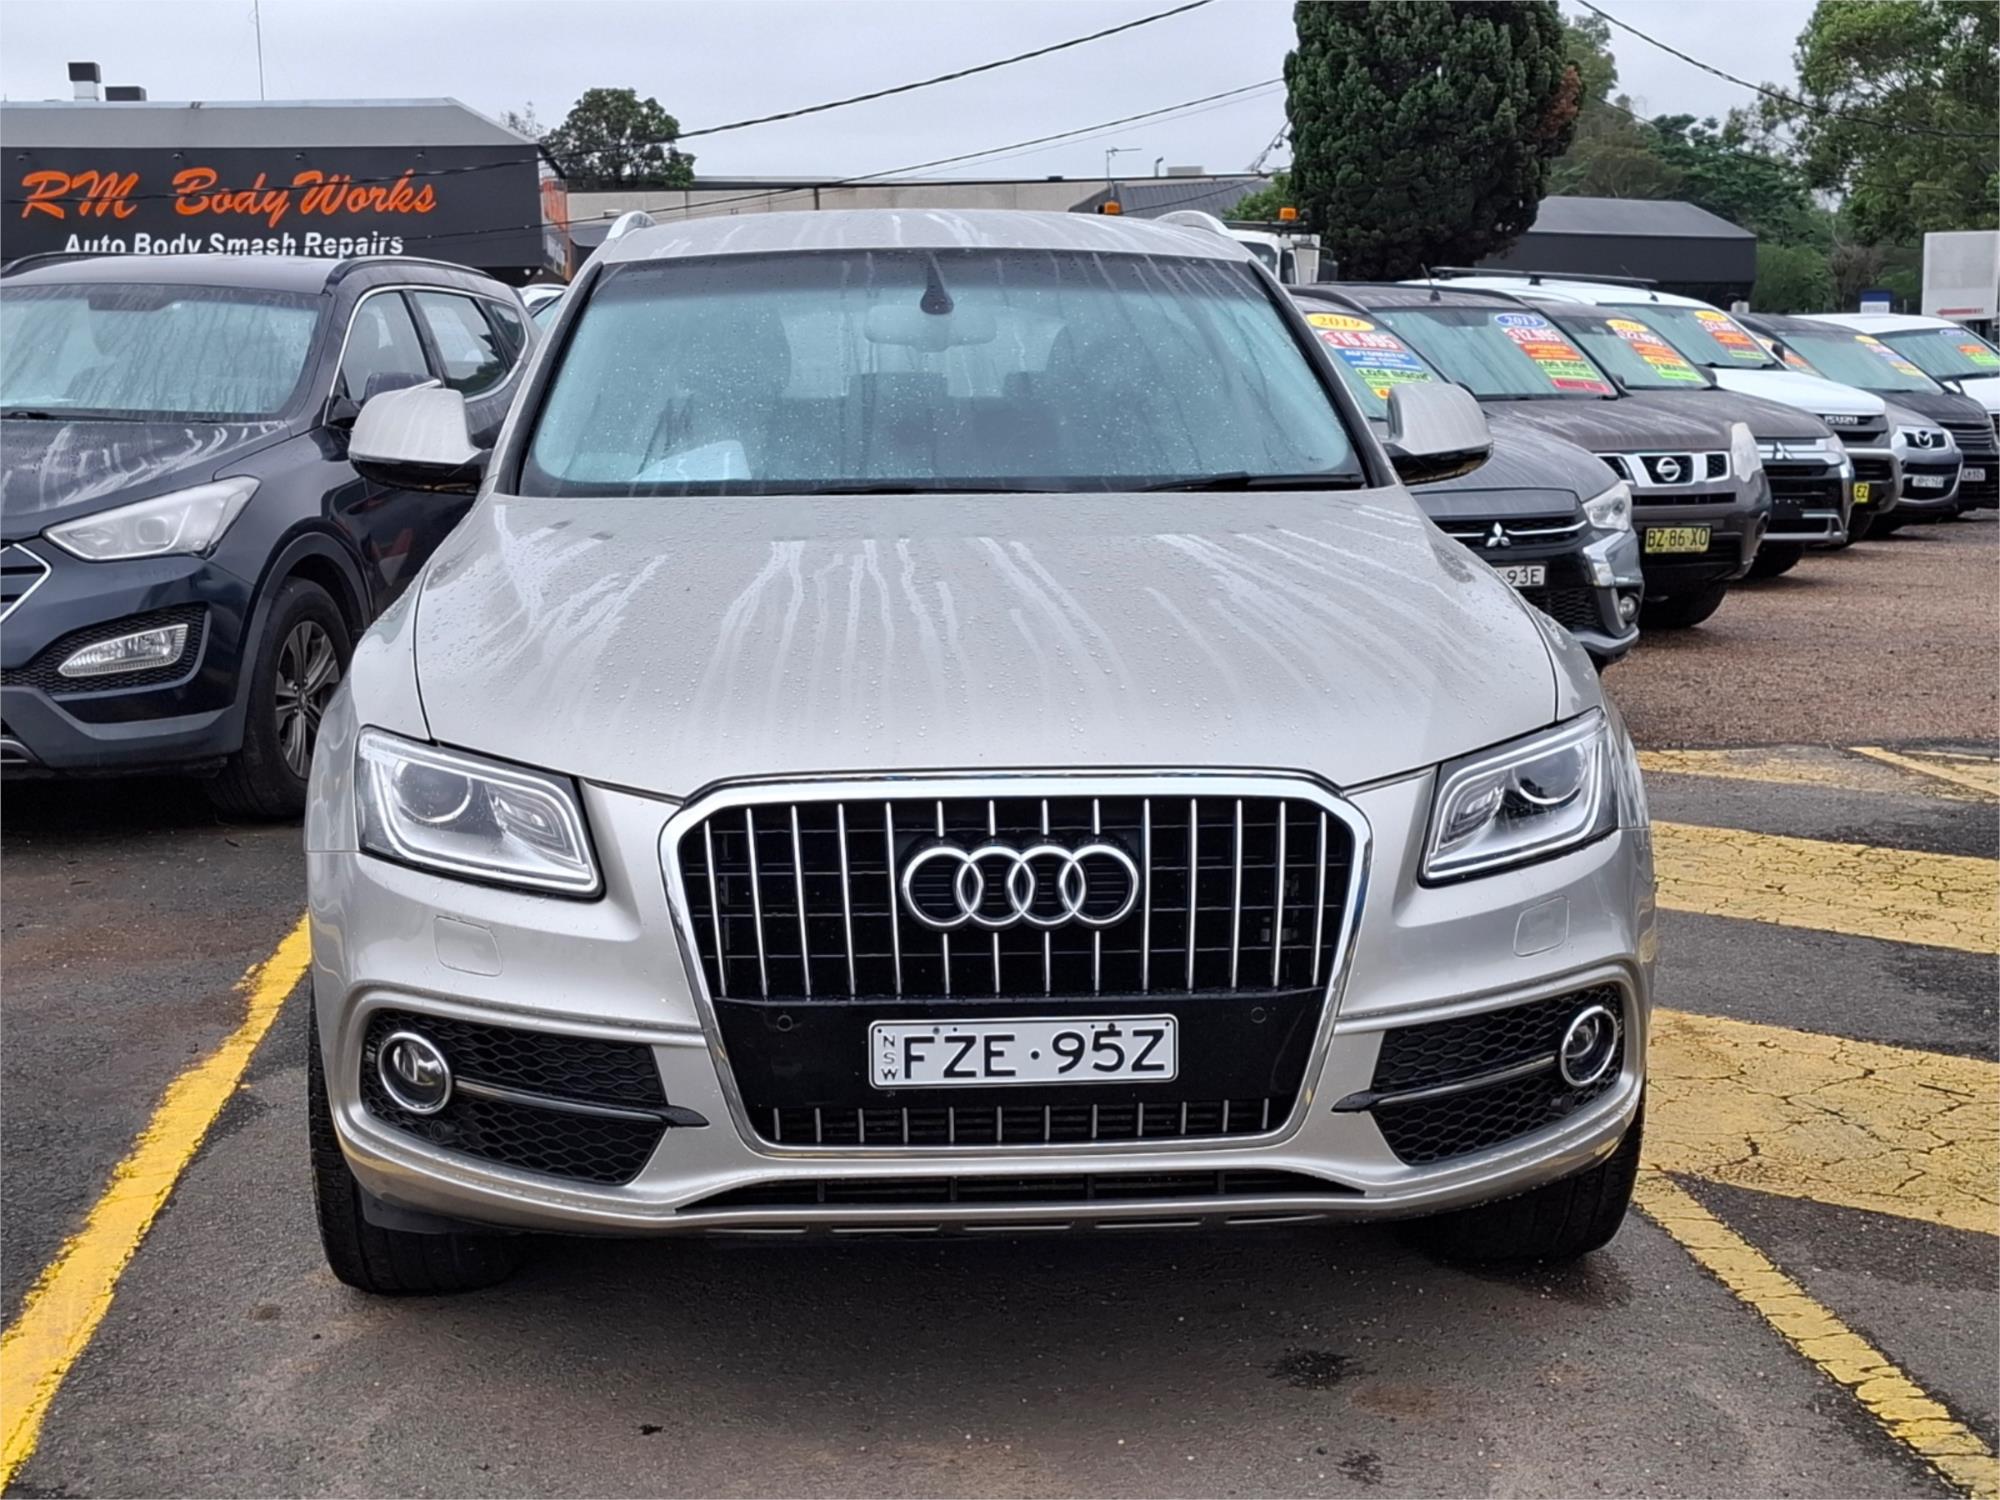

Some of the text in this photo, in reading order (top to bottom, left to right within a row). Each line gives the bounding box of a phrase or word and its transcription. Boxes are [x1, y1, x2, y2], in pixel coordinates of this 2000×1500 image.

[21, 169, 141, 220] RM
[64, 231, 404, 259] Auto Body Smash Repairs
[1319, 317, 1361, 328] 2019
[1824, 415, 1859, 425] ISUZU
